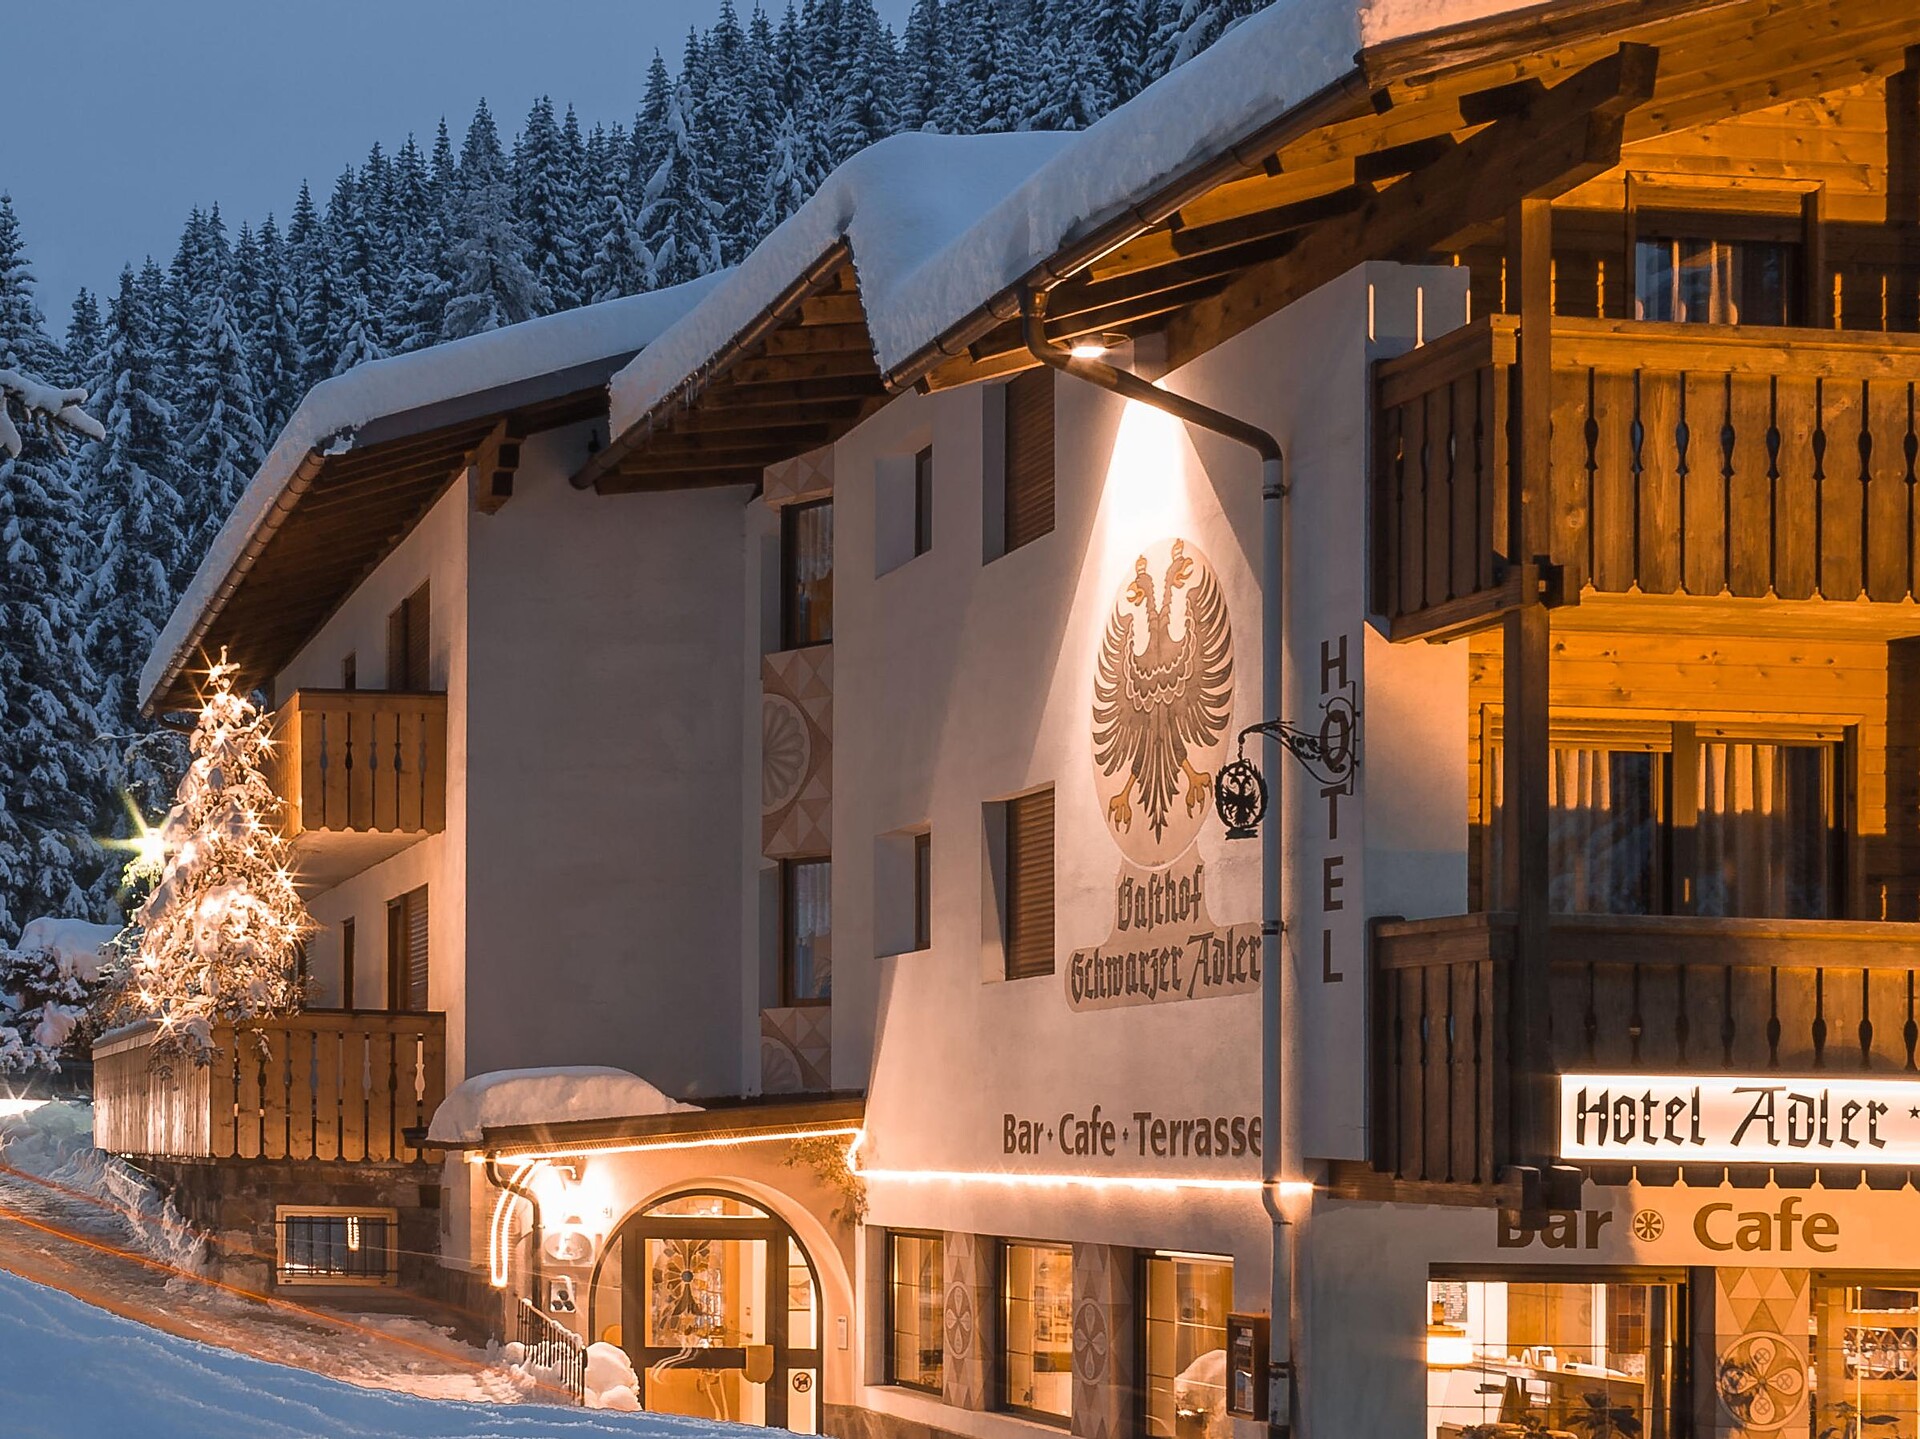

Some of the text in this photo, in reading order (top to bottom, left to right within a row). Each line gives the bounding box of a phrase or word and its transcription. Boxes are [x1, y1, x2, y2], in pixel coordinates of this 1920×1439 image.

[1320, 634, 1349, 984] HOTEL
[1071, 927, 1262, 1004] Schwarzer Adler
[1003, 1103, 1262, 1157] Bar Cafe Terrasse
[1576, 1085, 1889, 1149] Hotel Adler
[1693, 1196, 1840, 1252] Cafe
